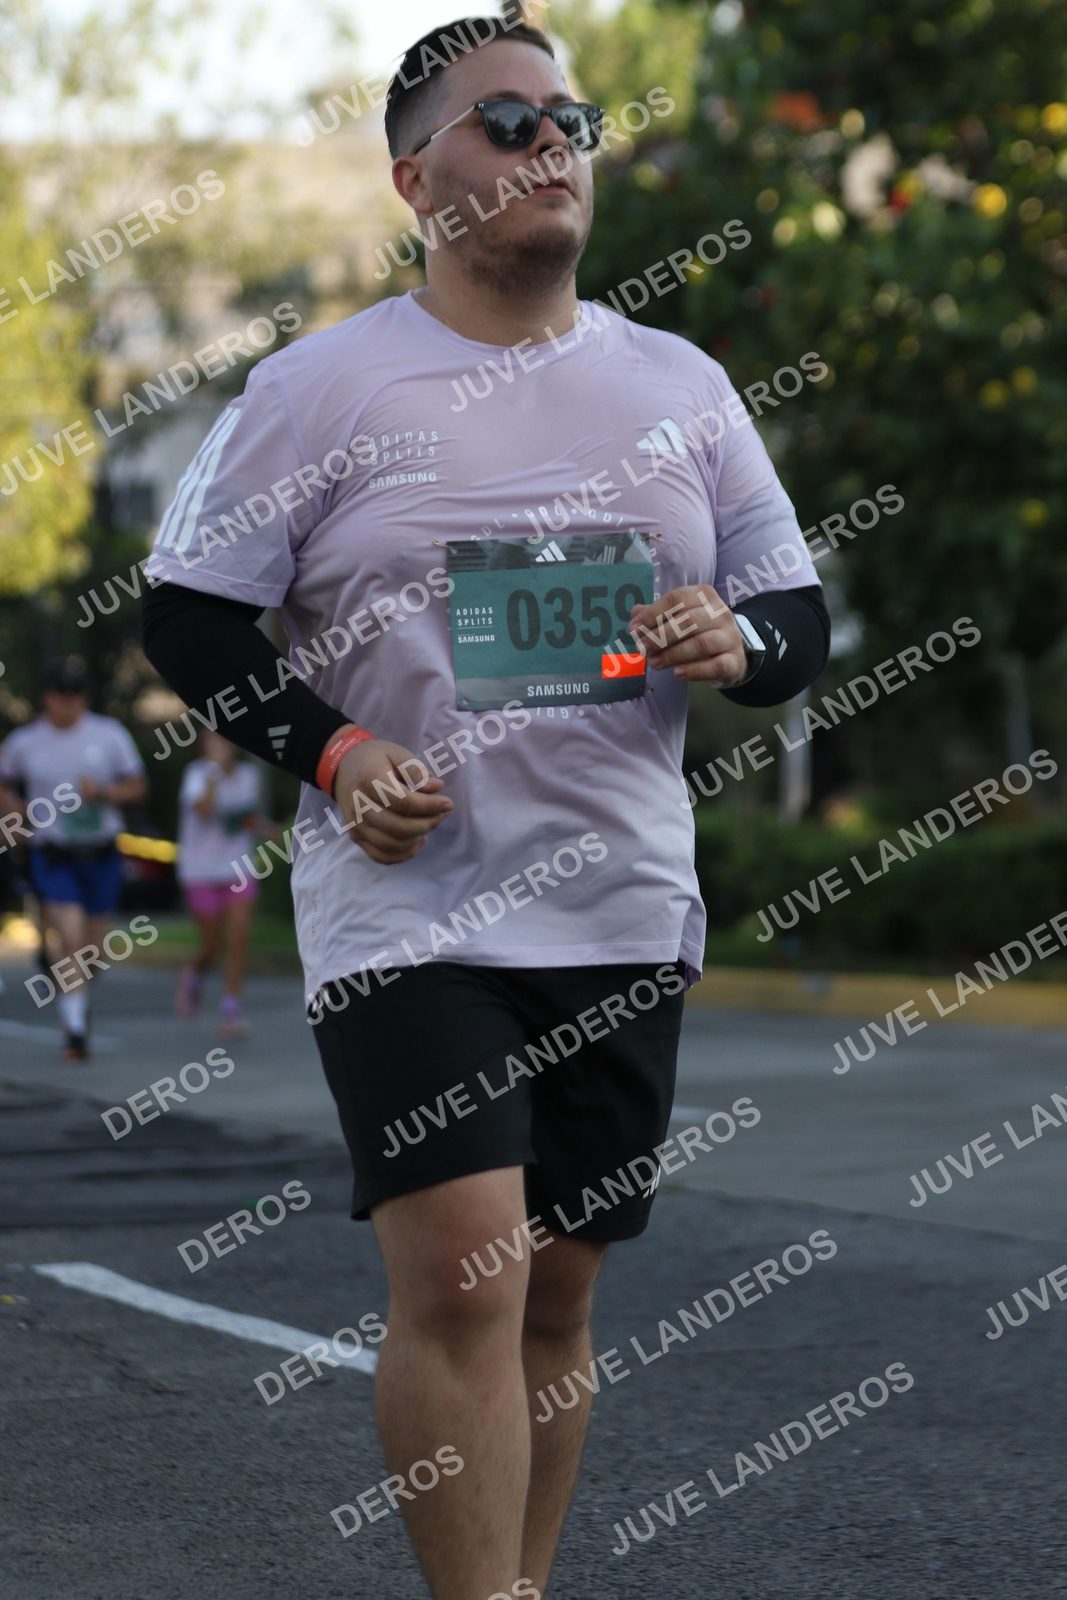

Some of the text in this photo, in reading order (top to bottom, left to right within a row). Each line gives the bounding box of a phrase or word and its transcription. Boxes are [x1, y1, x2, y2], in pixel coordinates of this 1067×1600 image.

[367, 431, 438, 449] ADIDAS
[368, 472, 437, 489] SAMSUNG
[456, 607, 493, 616] ADIDAS
[457, 617, 493, 626] SPLITS
[457, 634, 495, 643] SAMSUNG
[527, 682, 590, 697] SAMSUNG
